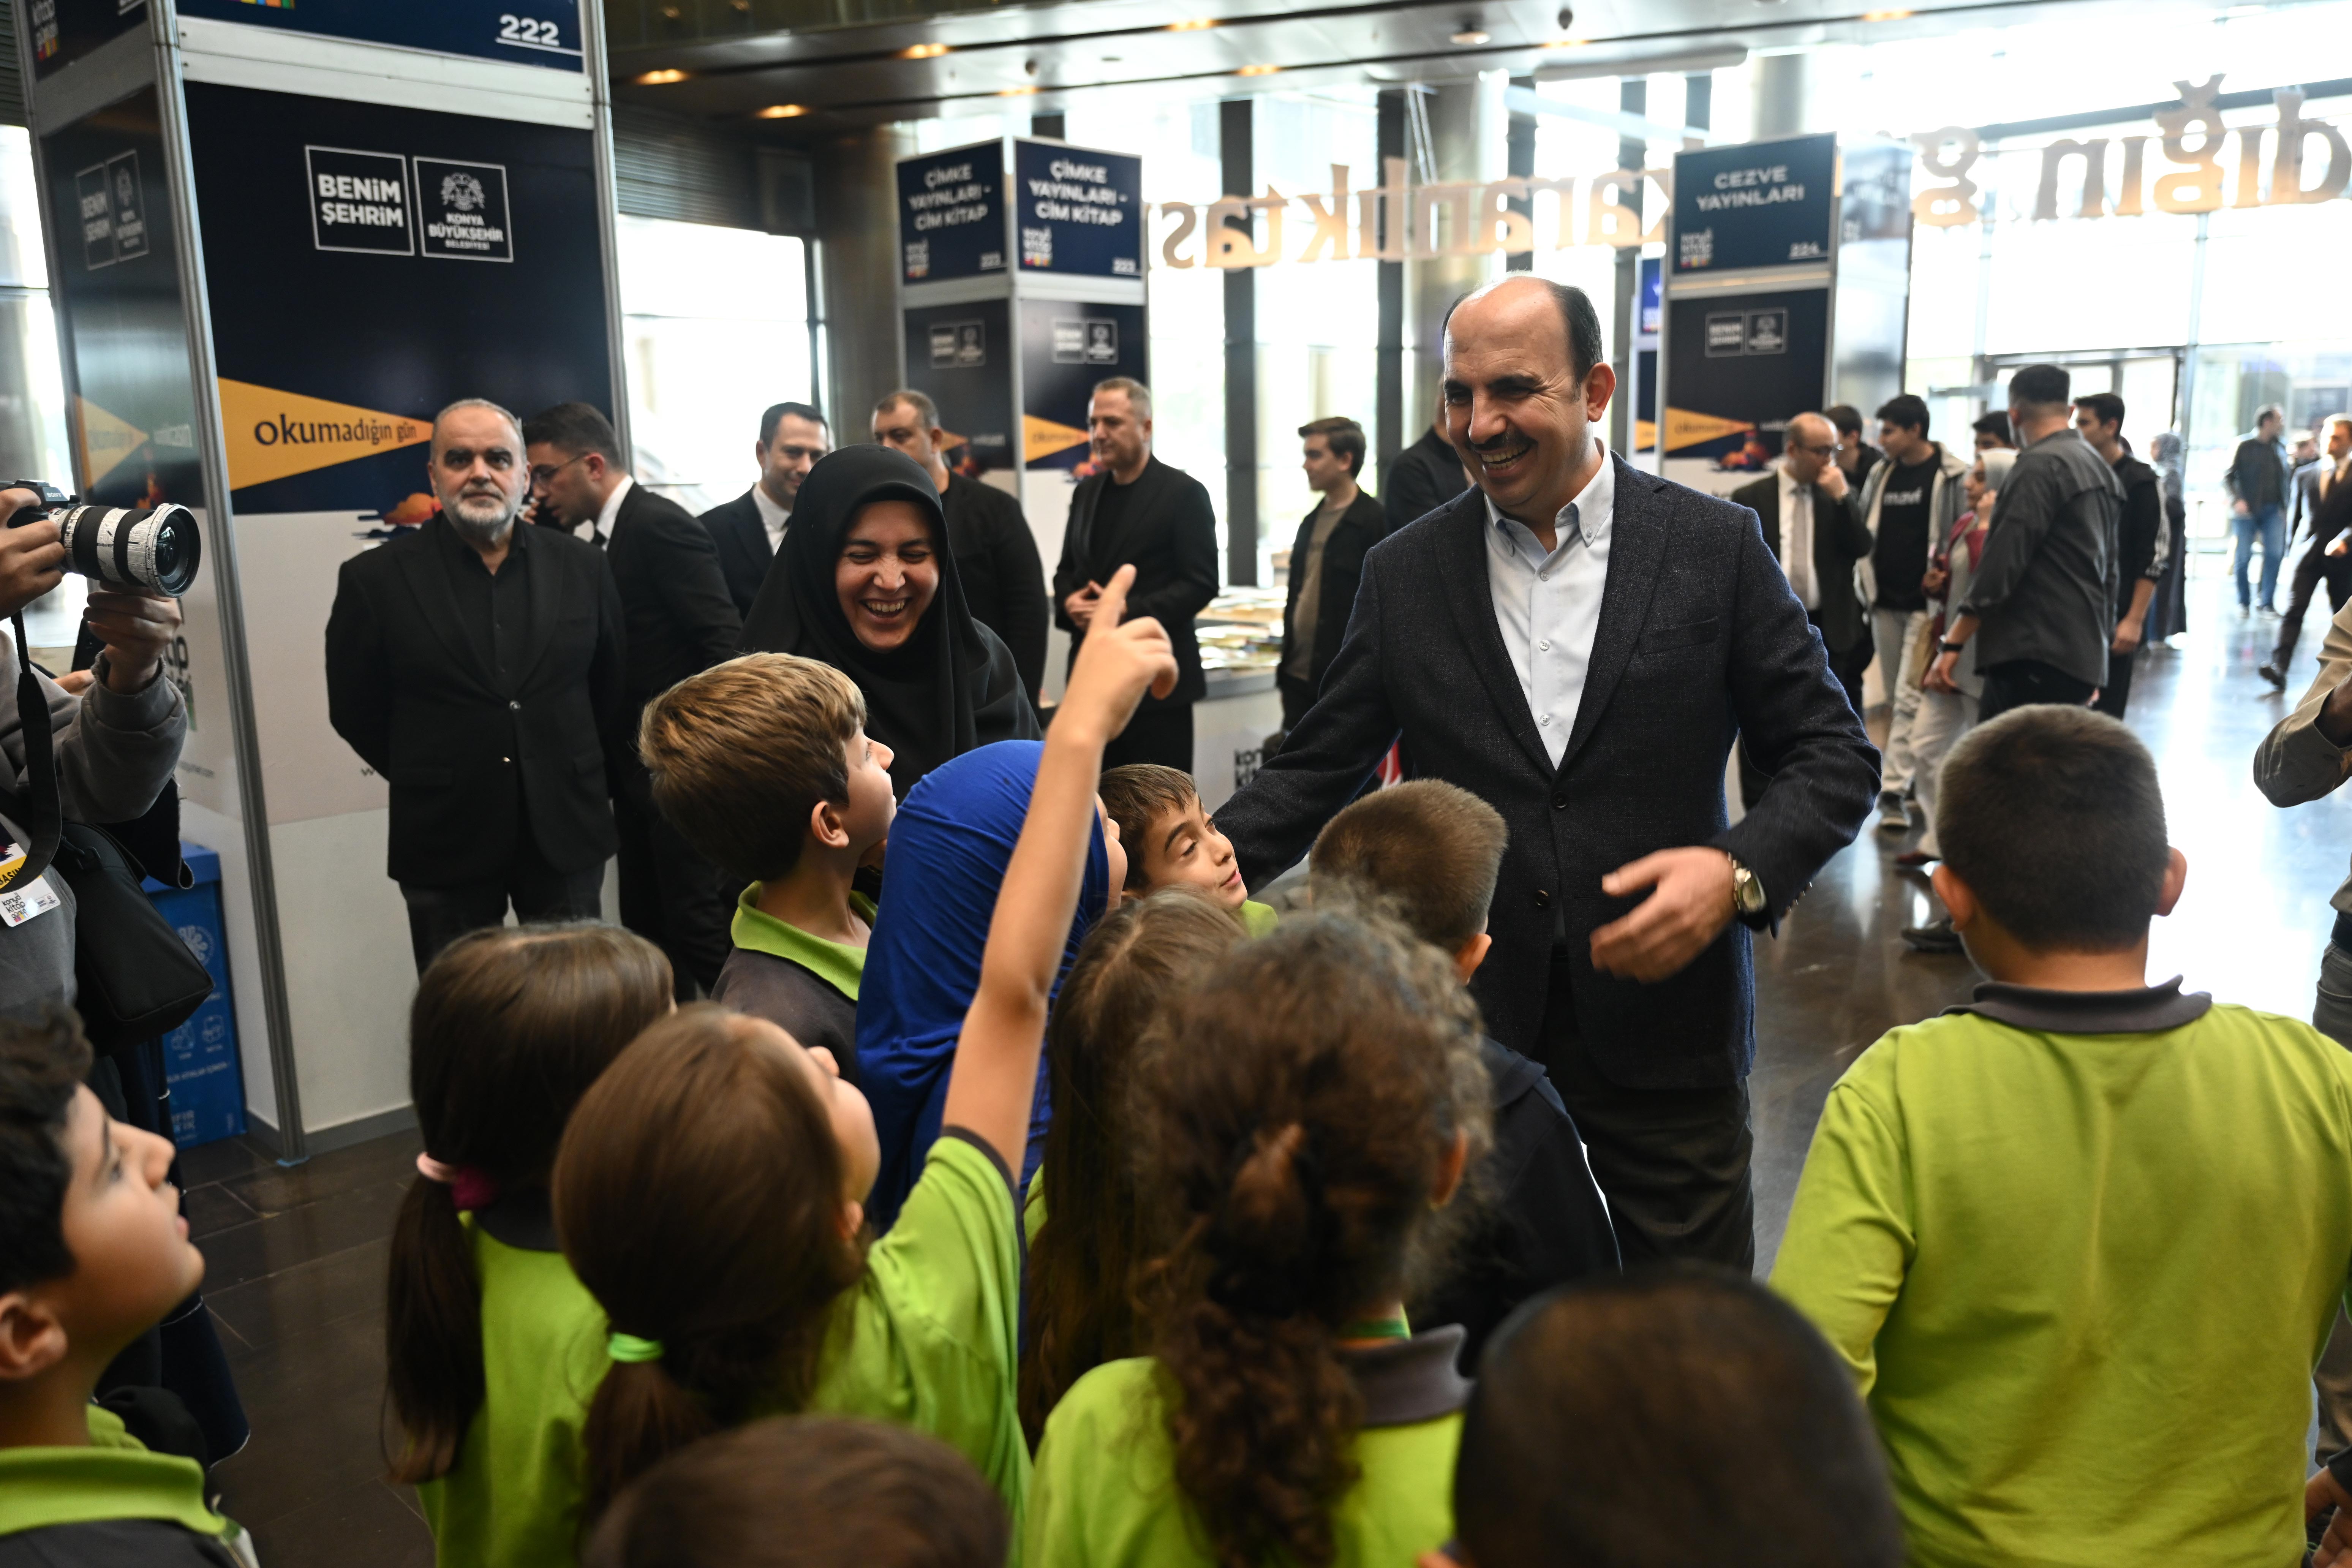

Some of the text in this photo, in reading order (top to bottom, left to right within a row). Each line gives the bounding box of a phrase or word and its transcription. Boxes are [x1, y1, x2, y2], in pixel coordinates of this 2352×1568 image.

[499, 14, 560, 47] 222
[1049, 157, 1107, 184] ÇİMKE
[1713, 164, 1789, 190] CEZVE
[318, 173, 401, 204] BENİM
[907, 182, 982, 211] YAYINLARI
[1028, 178, 1117, 206] YAYINLARI
[1696, 183, 1805, 212] YAYINLARI
[321, 201, 404, 228] ŞEHRİM
[446, 212, 485, 226] KONYA
[944, 203, 988, 226] KİTAP
[1035, 200, 1124, 227] CİM KİTAP
[428, 221, 504, 242] BÜYÜKŞEHİR
[1789, 242, 1819, 259] 224
[254, 413, 418, 445] okumadığın gün
[2, 895, 22, 907] konya
[6, 901, 26, 914] kitap
